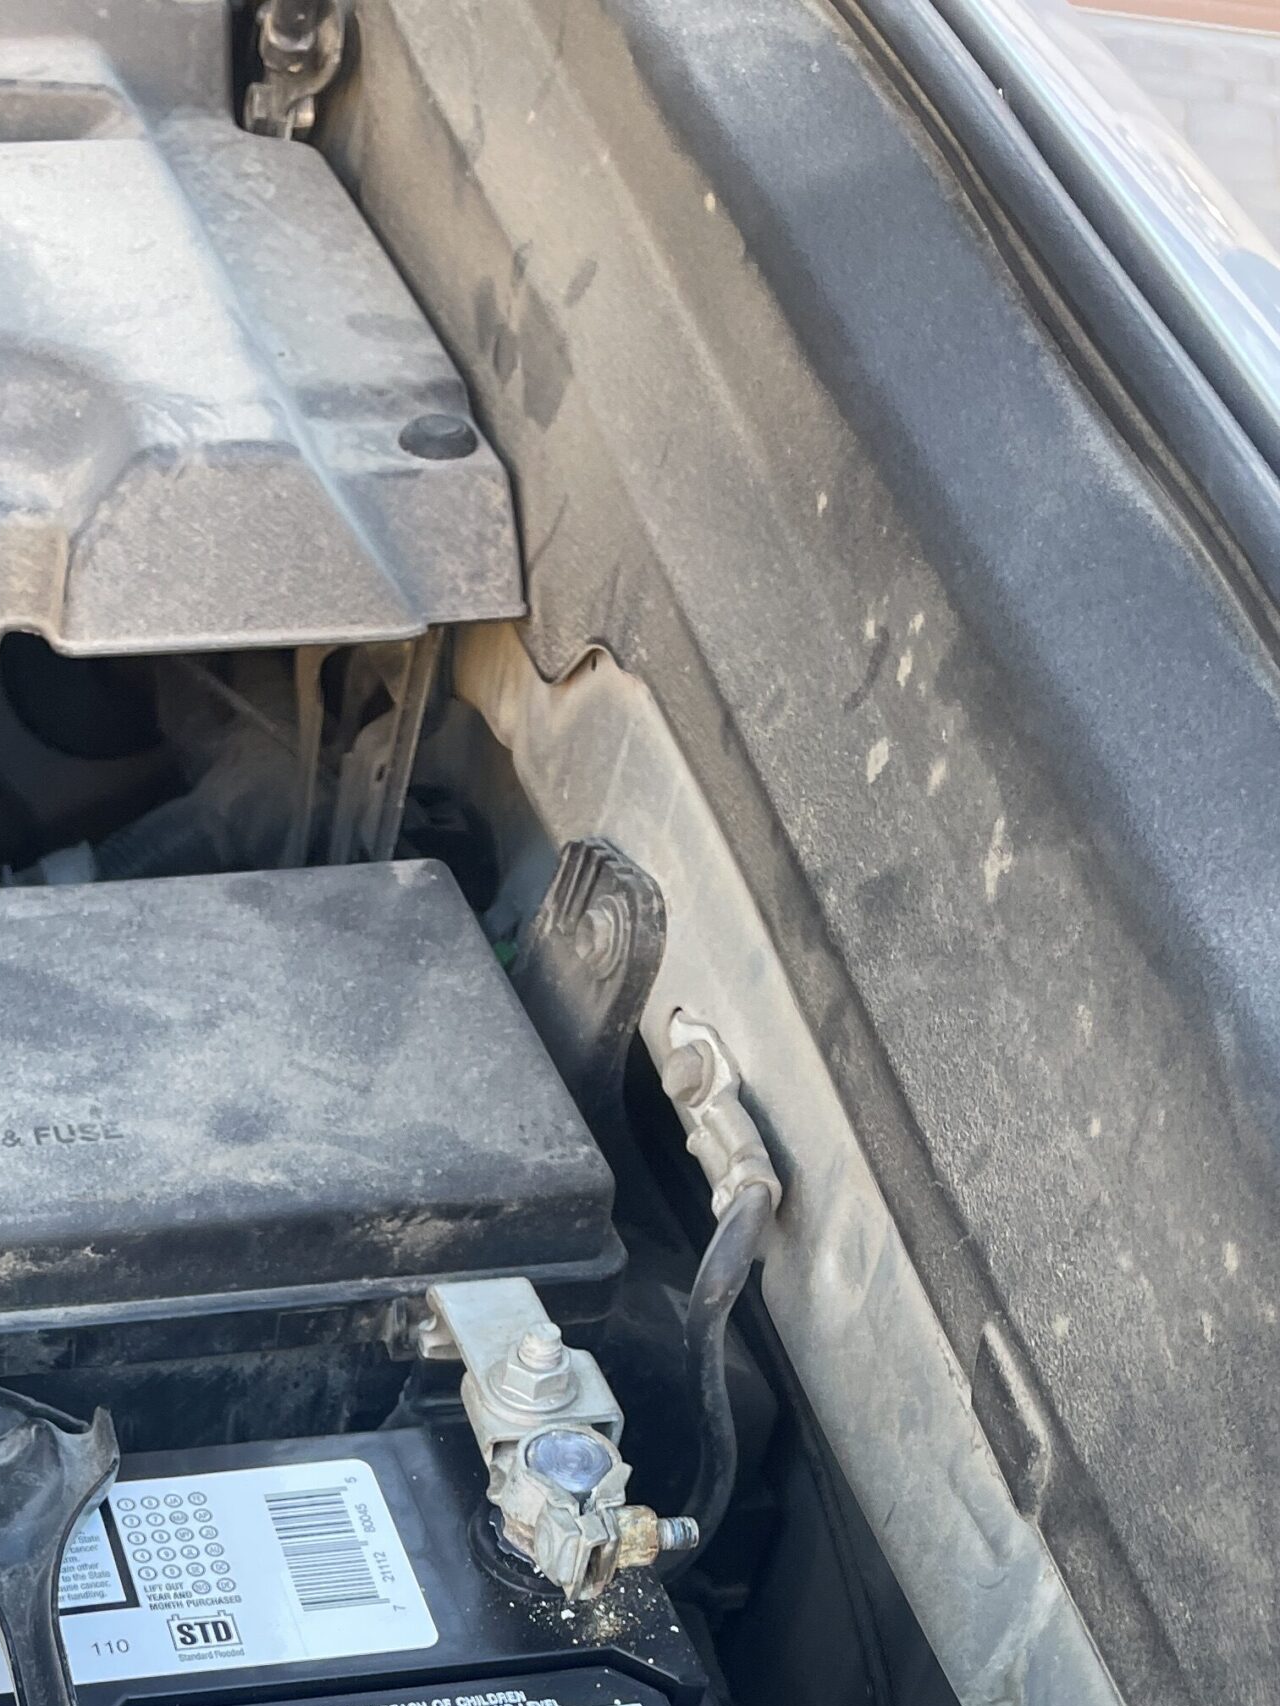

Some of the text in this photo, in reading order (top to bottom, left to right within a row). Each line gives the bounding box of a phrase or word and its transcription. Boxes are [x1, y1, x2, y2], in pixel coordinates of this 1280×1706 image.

[2, 1129, 24, 1148] &
[33, 1122, 124, 1147] FUSE
[344, 1476, 406, 1612] 7 21112 80045 5
[146, 1590, 193, 1601] YEAR AND
[149, 1595, 242, 1611] MONTH PURCHASED
[176, 1620, 233, 1646] STD
[91, 1638, 129, 1656] 110
[178, 1650, 213, 1662] Standard
